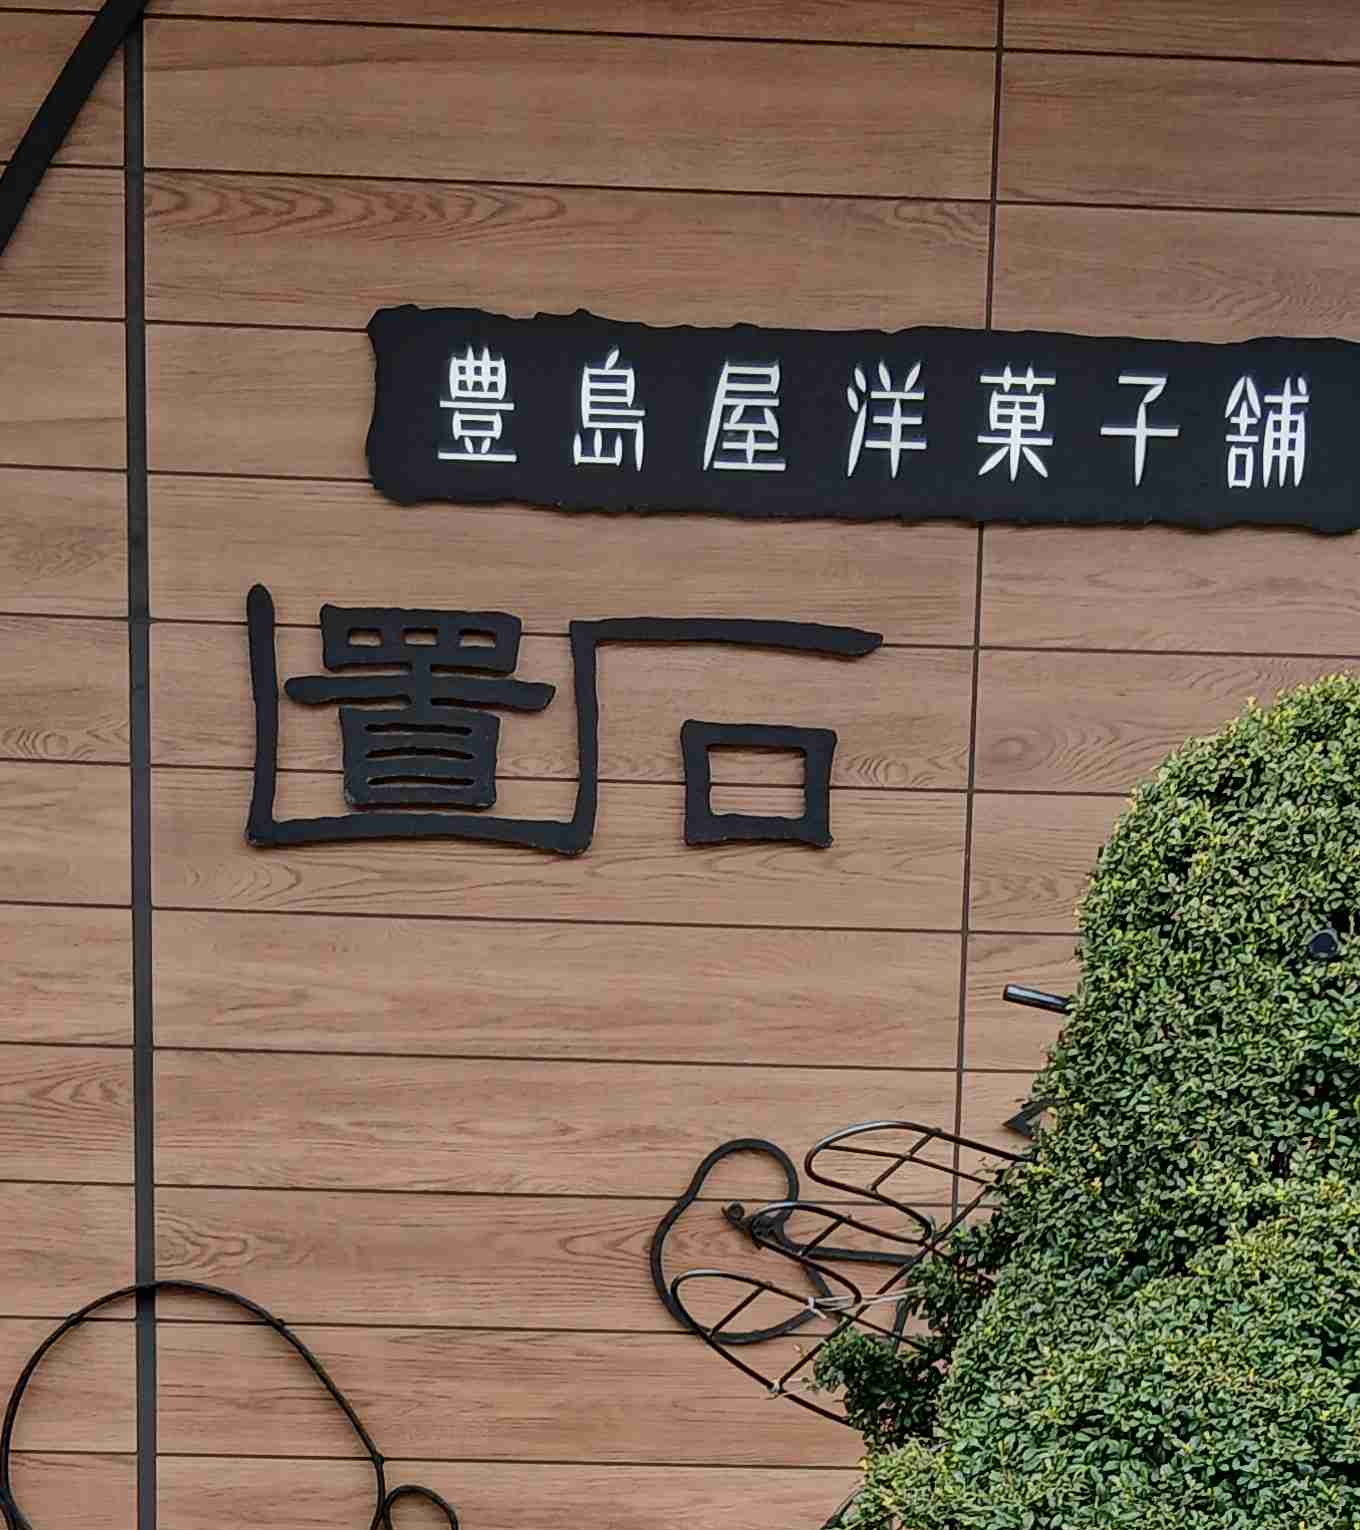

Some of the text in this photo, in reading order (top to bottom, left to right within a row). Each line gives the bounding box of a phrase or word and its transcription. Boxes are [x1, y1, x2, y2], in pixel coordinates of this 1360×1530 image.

[437, 345, 1310, 489] 豊島屋洋菓子舗
